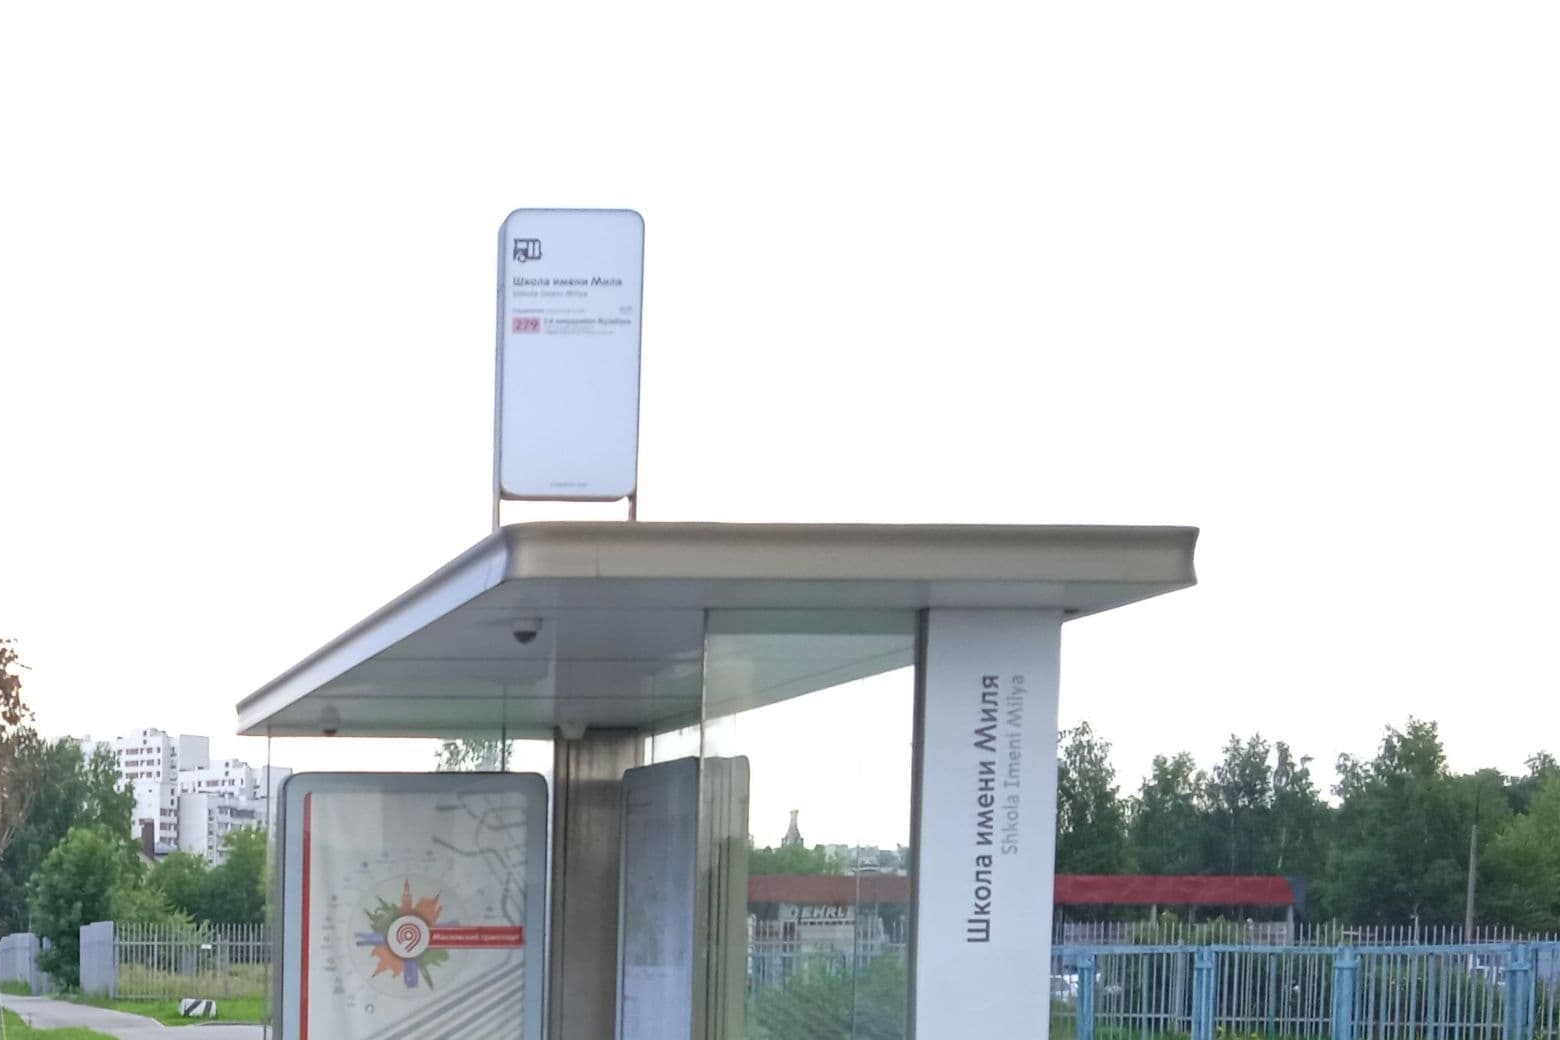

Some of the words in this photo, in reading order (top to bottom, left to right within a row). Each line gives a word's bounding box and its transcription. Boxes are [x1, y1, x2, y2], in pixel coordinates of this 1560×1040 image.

[512, 276, 550, 287] Школа
[552, 277, 588, 287] имени
[973, 674, 1000, 752] Миля
[1005, 673, 1028, 728] Milya
[1003, 733, 1022, 789] Imeni
[975, 760, 996, 846] имени
[1001, 793, 1020, 856] Shkola
[966, 854, 993, 943] Школа
